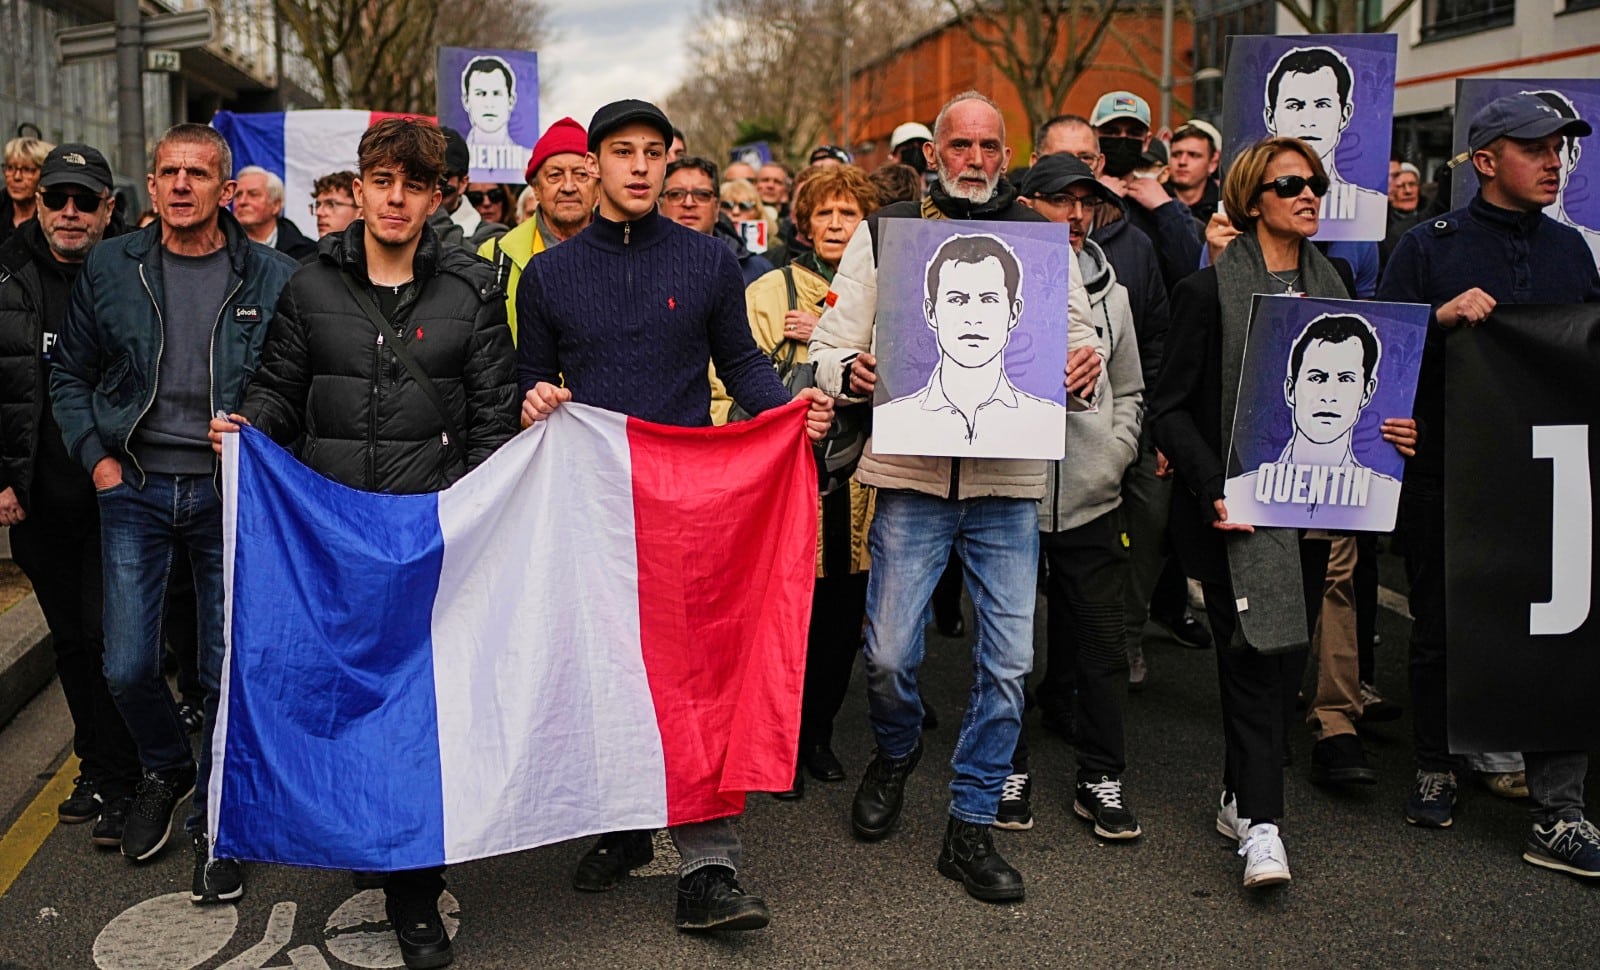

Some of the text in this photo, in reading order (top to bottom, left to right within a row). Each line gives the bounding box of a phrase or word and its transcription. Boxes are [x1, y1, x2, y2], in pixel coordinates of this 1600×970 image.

[467, 144, 524, 169] UENTIN
[1255, 462, 1372, 507] QUENTIN
[1529, 424, 1593, 636] J
